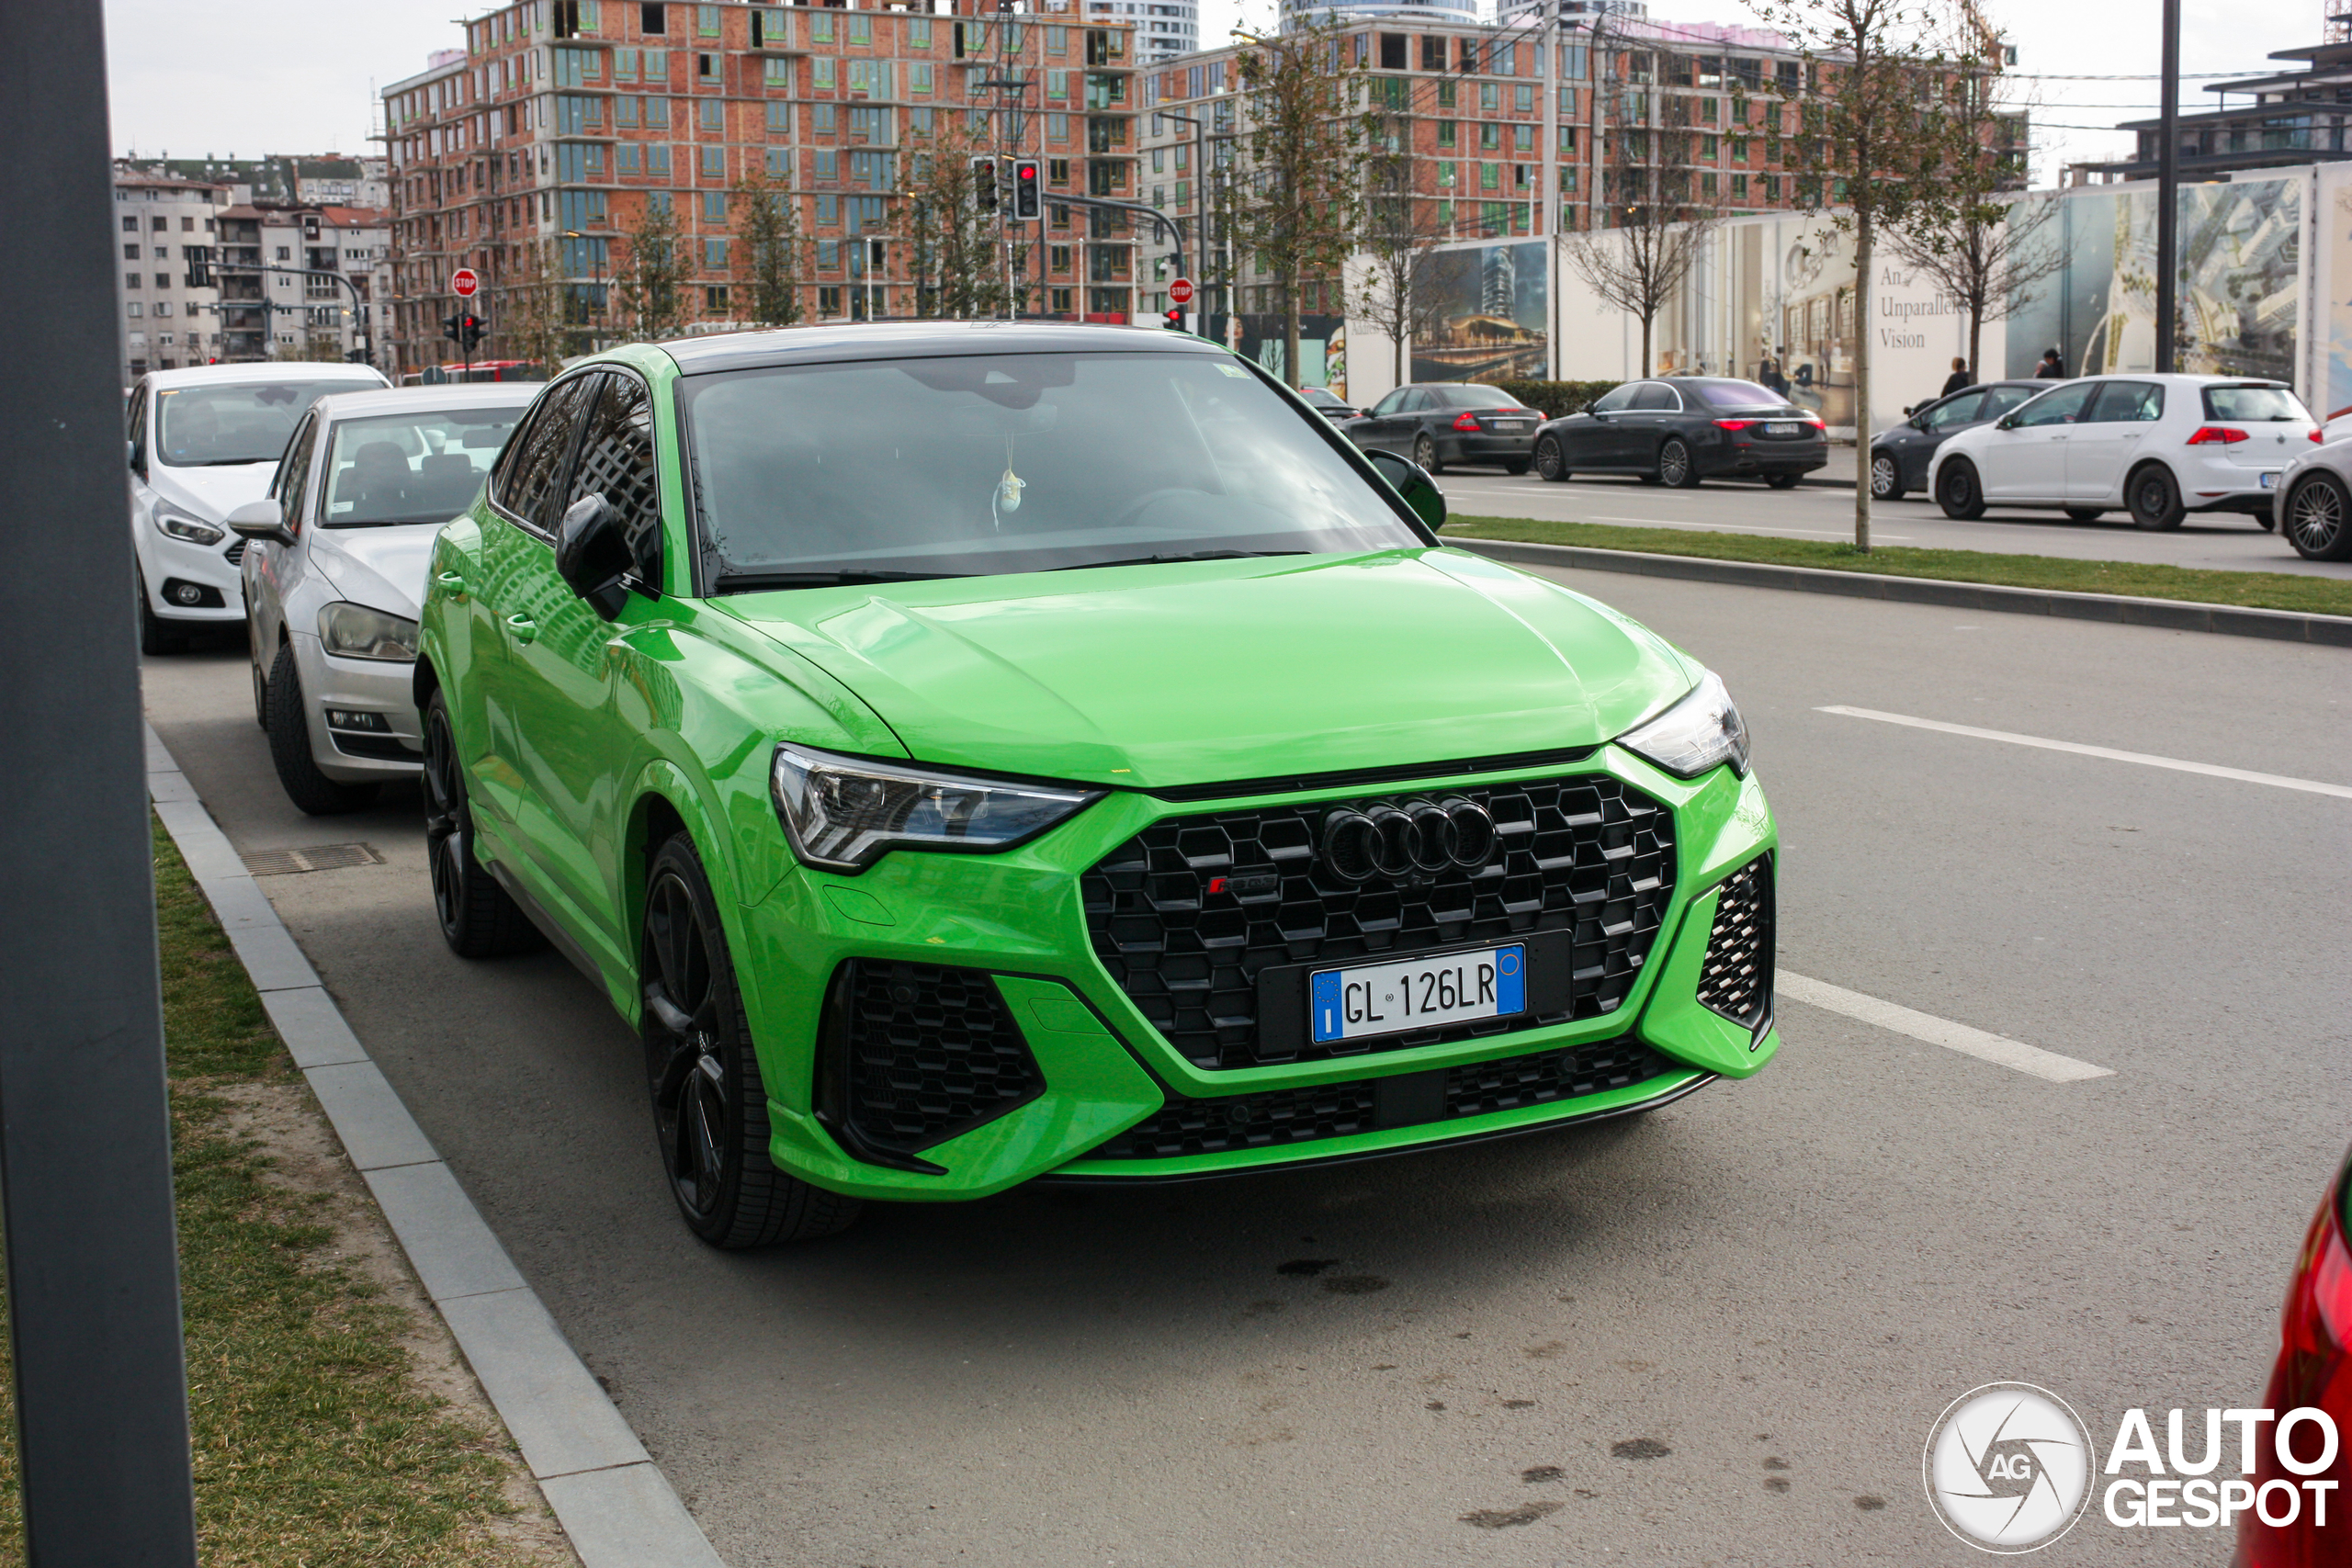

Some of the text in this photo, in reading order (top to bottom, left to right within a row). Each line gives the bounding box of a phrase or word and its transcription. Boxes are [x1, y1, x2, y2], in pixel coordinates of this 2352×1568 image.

[455, 277, 475, 288] STOP
[1880, 265, 1901, 285] An
[1171, 287, 1192, 296] STOP
[1881, 328, 1925, 348] Vision
[1345, 963, 1496, 1023] GL 126LR
